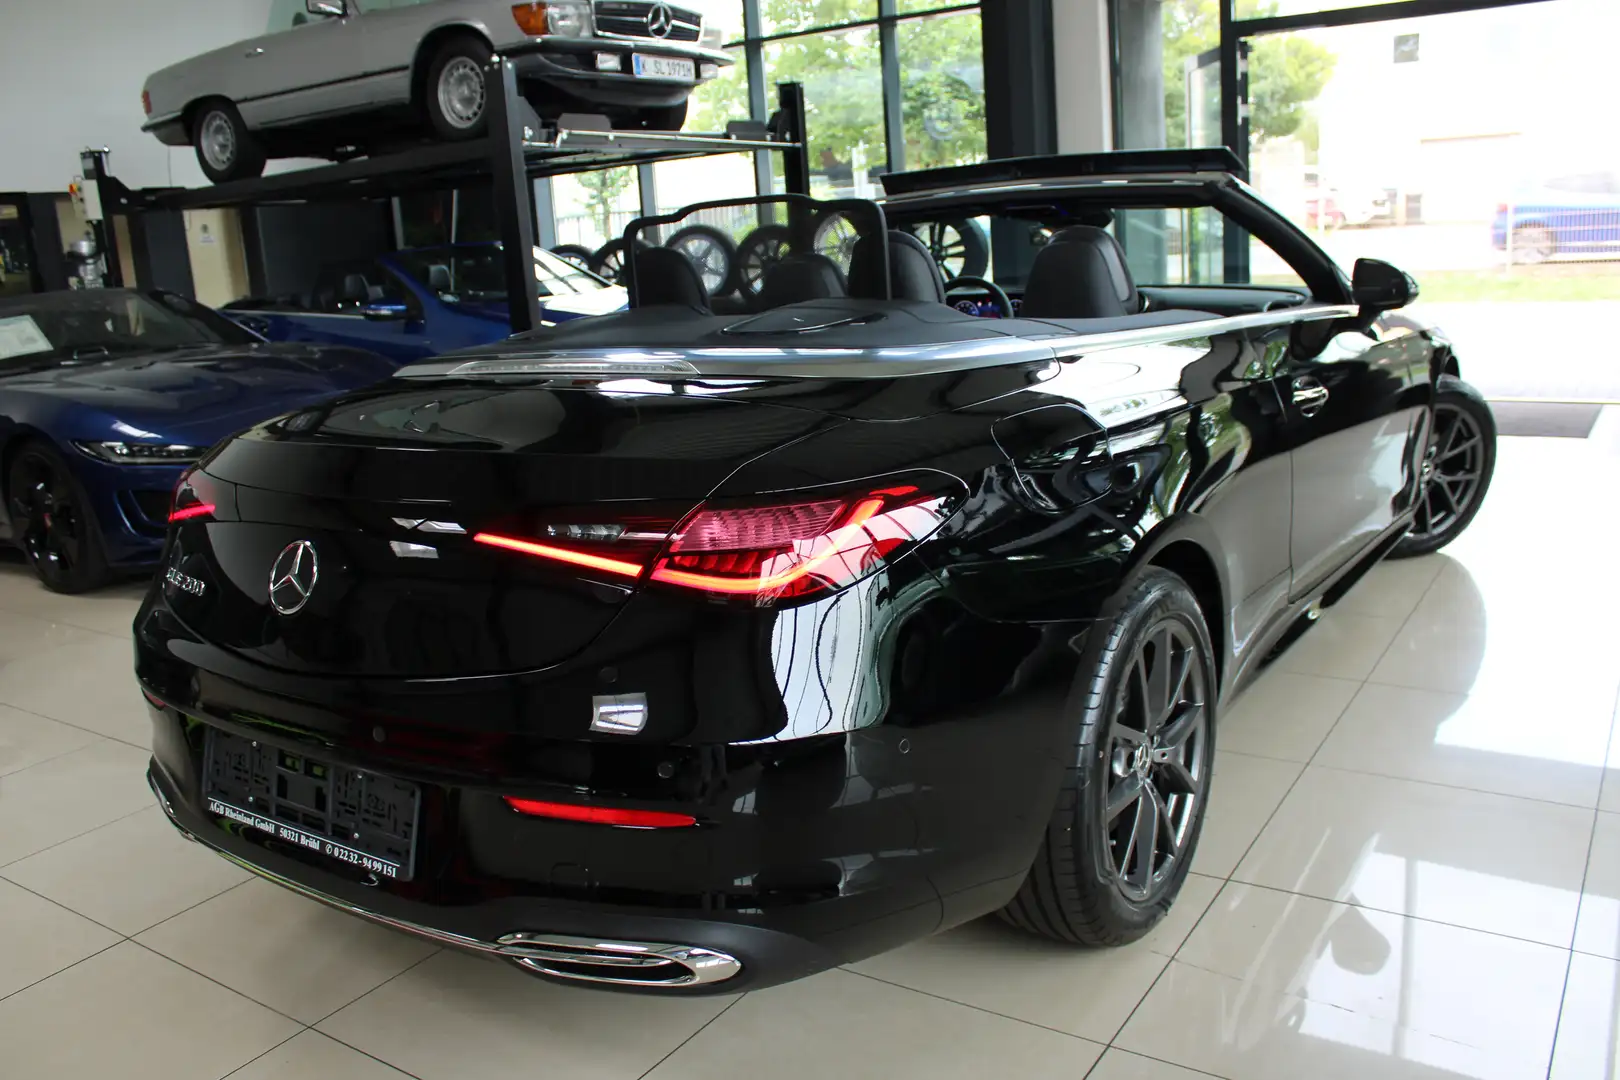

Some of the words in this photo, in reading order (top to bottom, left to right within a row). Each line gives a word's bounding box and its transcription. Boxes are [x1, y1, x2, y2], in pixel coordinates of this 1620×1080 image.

[654, 60, 666, 75] SL
[208, 801, 225, 815] AGB
[225, 808, 255, 826] Rheinland
[255, 818, 276, 834] GmbH
[280, 827, 299, 843] 50321
[300, 834, 320, 851] Brühl
